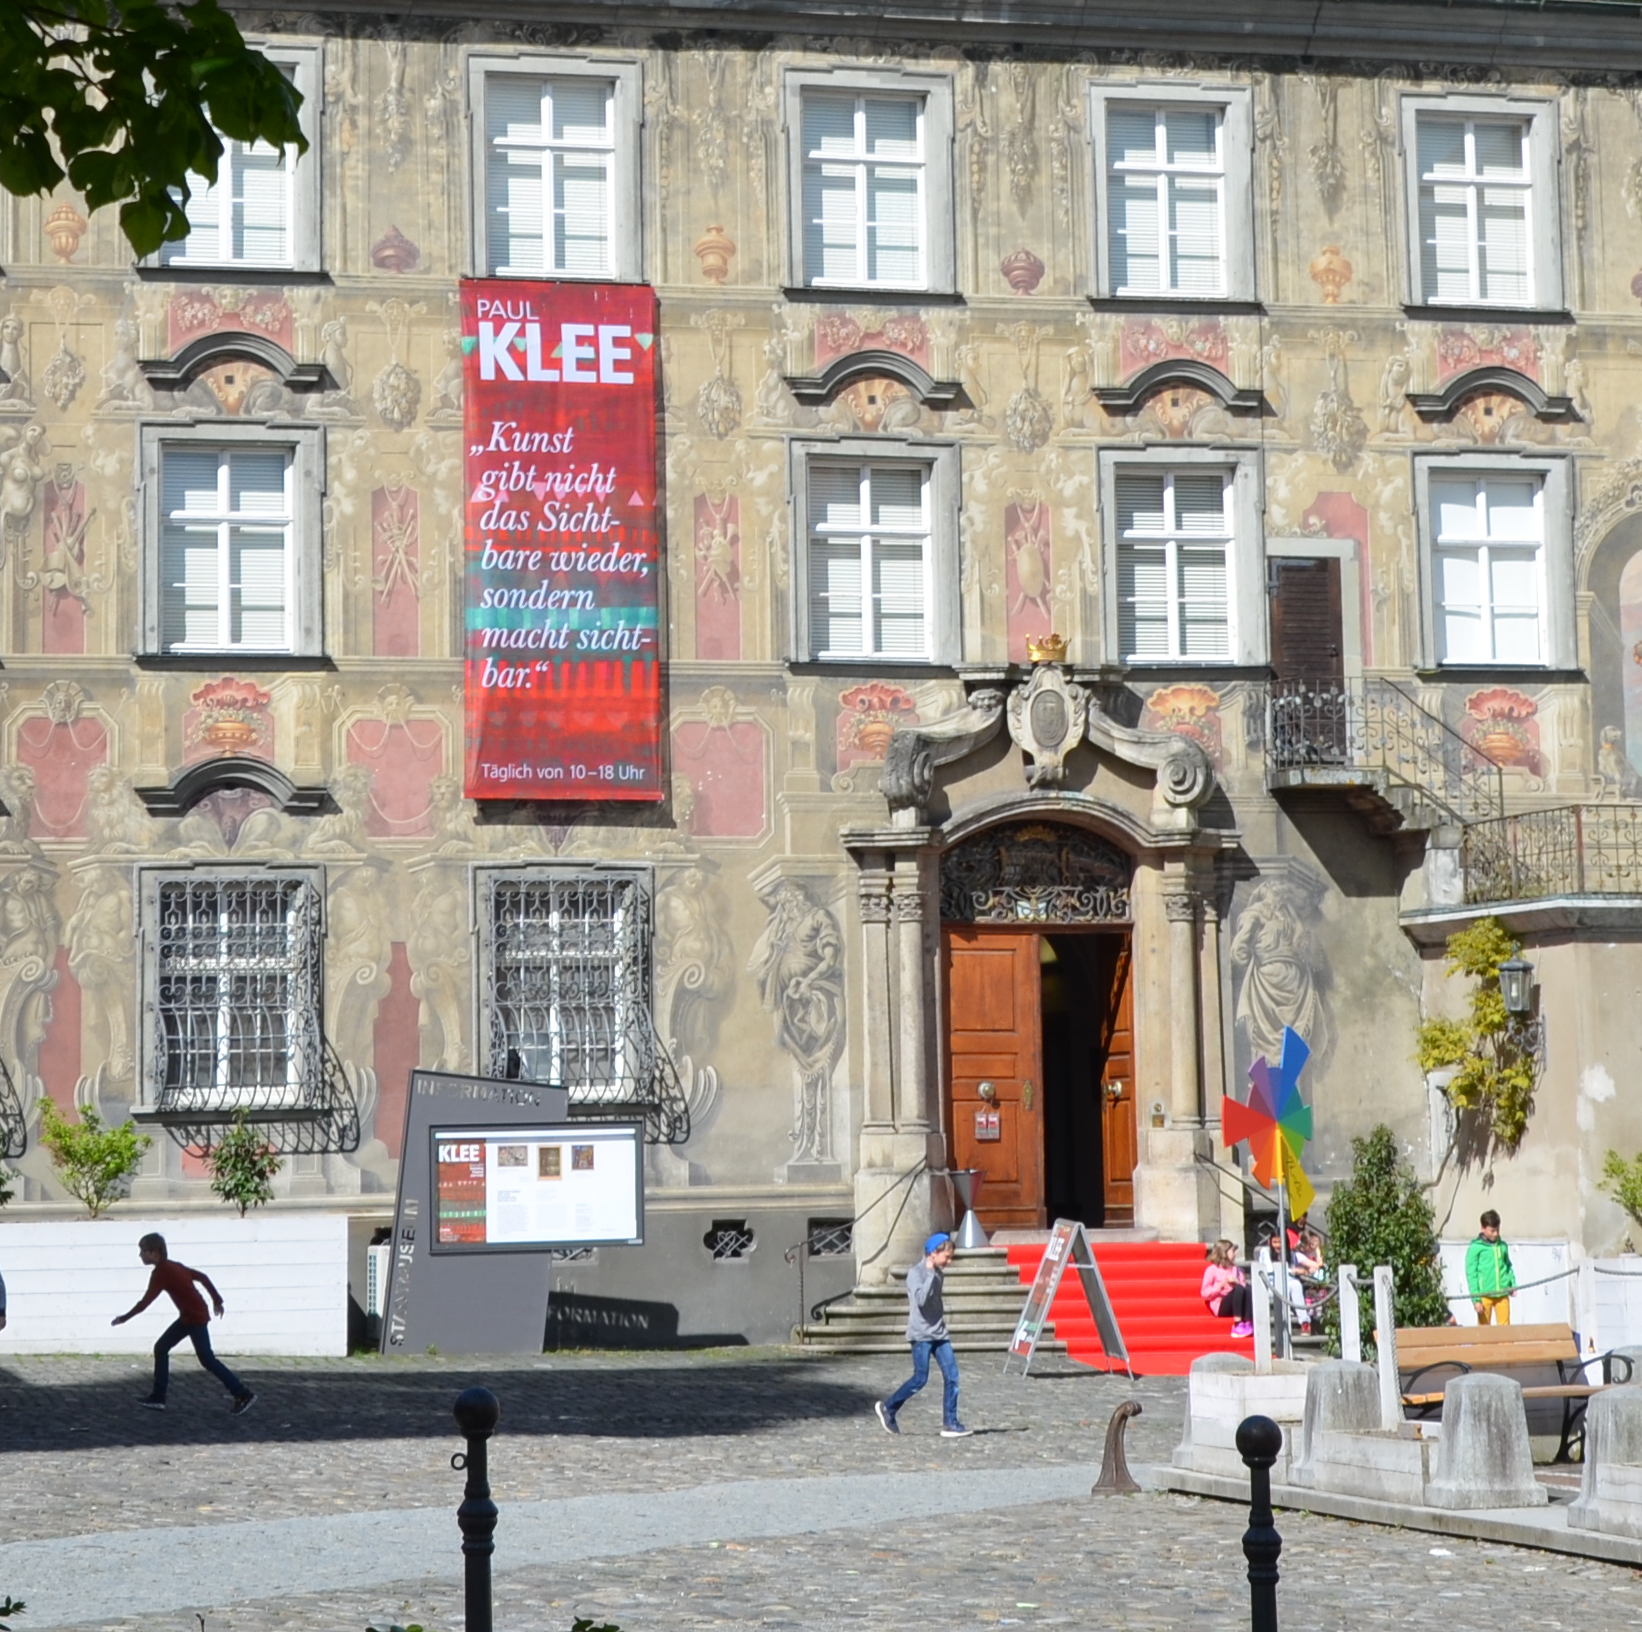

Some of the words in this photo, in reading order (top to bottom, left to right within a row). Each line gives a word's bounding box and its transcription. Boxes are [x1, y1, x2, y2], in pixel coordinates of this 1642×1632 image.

[477, 299, 539, 320] PAUL
[478, 321, 634, 384] KLEE
[469, 421, 574, 456] „Kunst
[477, 461, 537, 501] gibt
[544, 463, 617, 493] nicht
[479, 501, 531, 531] das
[537, 501, 621, 533] Sicht-
[481, 539, 542, 571] bare
[549, 542, 649, 578] wieder,
[480, 579, 596, 611] sondern
[481, 619, 570, 650] macht
[576, 620, 652, 651] sicht-
[481, 763, 533, 783] Täglich
[536, 767, 564, 780] von
[618, 765, 645, 780] Uhr
[438, 1144, 480, 1163] KLEE
